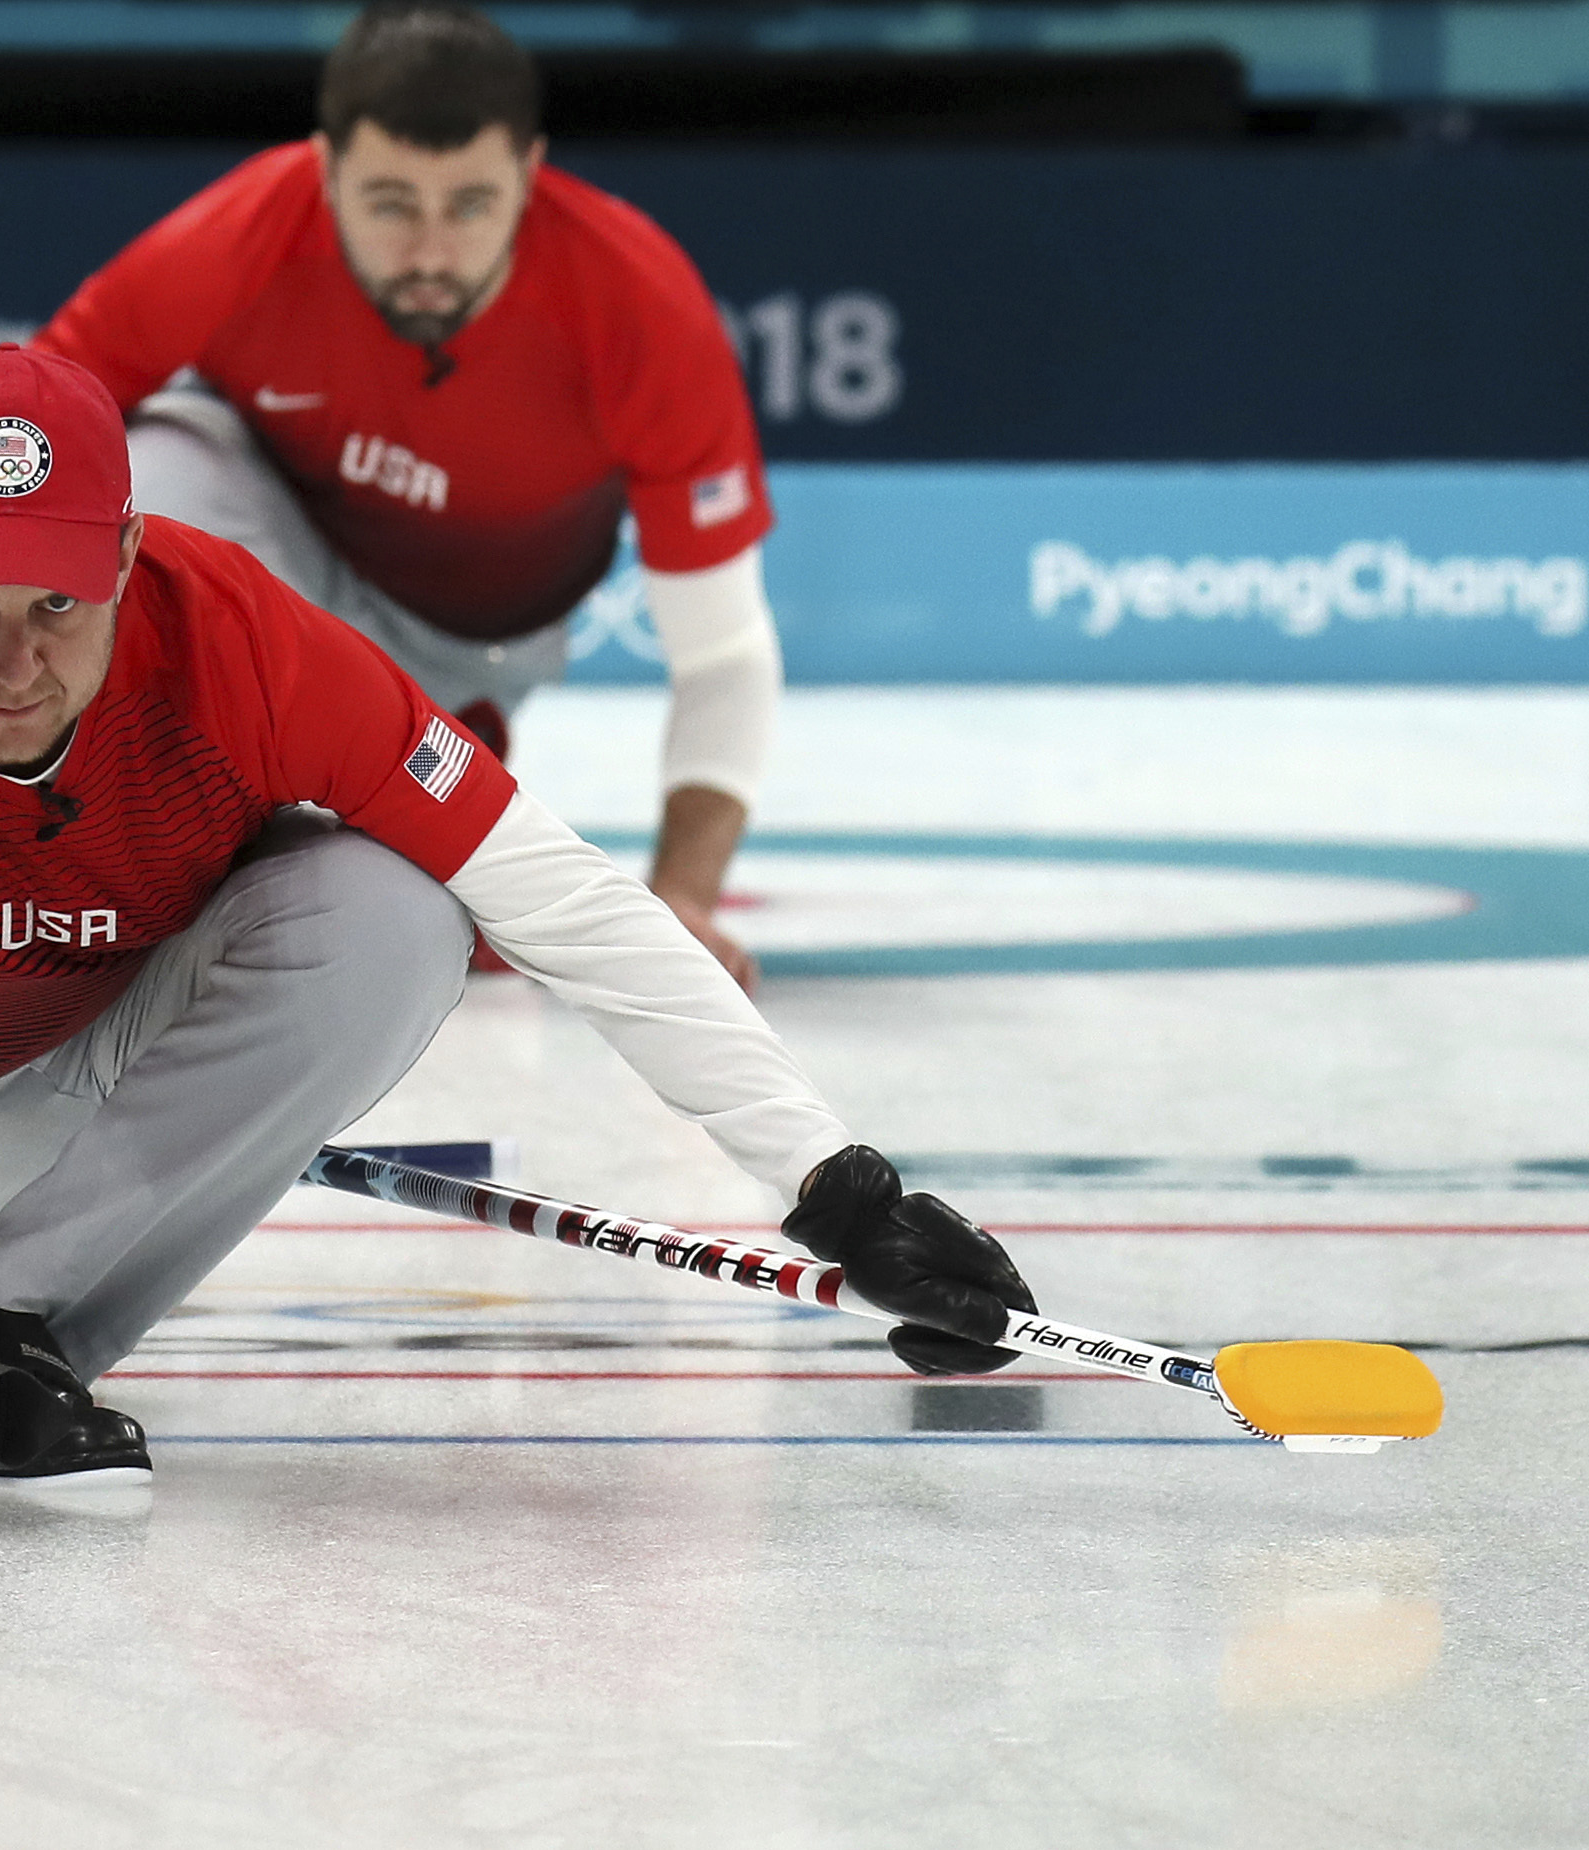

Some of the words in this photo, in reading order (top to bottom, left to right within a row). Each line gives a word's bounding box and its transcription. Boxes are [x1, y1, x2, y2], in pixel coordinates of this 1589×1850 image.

[716, 290, 905, 423] 18
[12, 420, 45, 446] STATES
[21, 468, 46, 491] TEAM
[339, 432, 450, 513] USA
[1028, 537, 1586, 636] PyeongChang
[1, 900, 116, 950] USA
[556, 1210, 779, 1290] Hardline
[1013, 1321, 1154, 1369] Hardline
